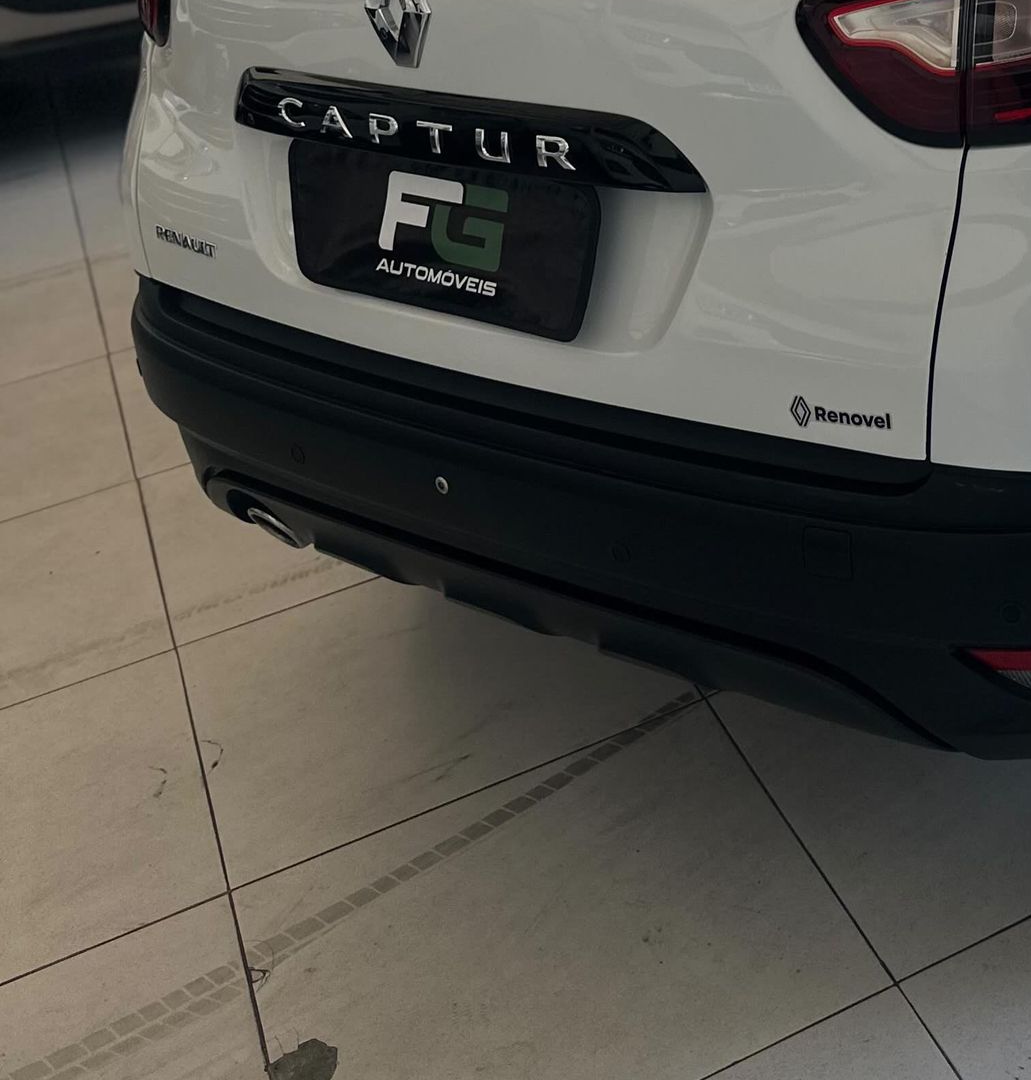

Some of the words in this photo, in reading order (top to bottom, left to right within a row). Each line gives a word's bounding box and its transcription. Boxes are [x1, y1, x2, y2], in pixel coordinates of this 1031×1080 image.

[277, 97, 576, 171] CAPTUR
[378, 170, 509, 272] FG
[155, 224, 217, 259] RENAULT
[375, 257, 497, 297] AUTOMÓVEIS
[814, 406, 891, 429] Renovel
